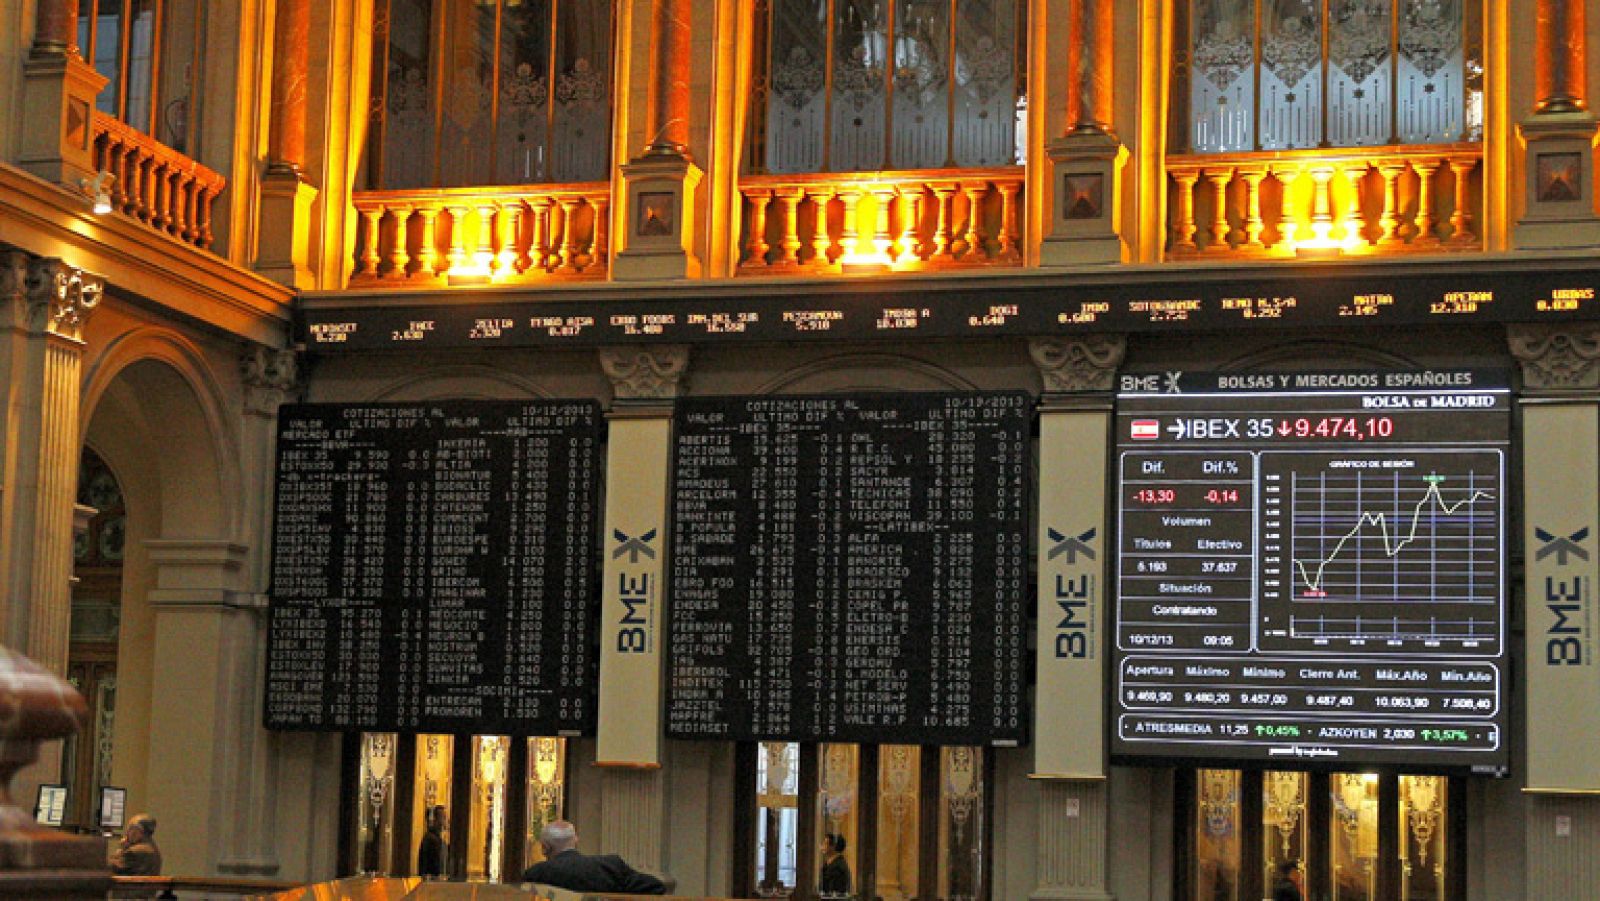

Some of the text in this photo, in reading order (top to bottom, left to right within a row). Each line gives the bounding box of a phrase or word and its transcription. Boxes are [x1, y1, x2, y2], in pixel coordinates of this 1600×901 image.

[1121, 374, 1159, 392] BME
[1218, 370, 1472, 389] BOLSAS Y MERCADOS ESPAÑOLES
[1362, 396, 1411, 408] BOLSA
[1430, 395, 1495, 408] MADRID
[1187, 417, 1393, 440] IBEX 35 9.474,10
[1143, 460, 1165, 473] Dif.
[1203, 460, 1239, 473] Dif.%
[1133, 489, 1175, 504] -13,30
[1204, 489, 1239, 504] -0,14
[1162, 515, 1211, 527] Volumen
[1198, 537, 1243, 549] Efectivo
[1158, 581, 1212, 594] Situación
[617, 572, 648, 654] BME
[1055, 573, 1088, 660] BME
[1152, 604, 1217, 616] Contratando
[1545, 575, 1582, 666] BME
[1126, 664, 1174, 678] Apertura
[1135, 722, 1214, 735] ATRESMEDIA
